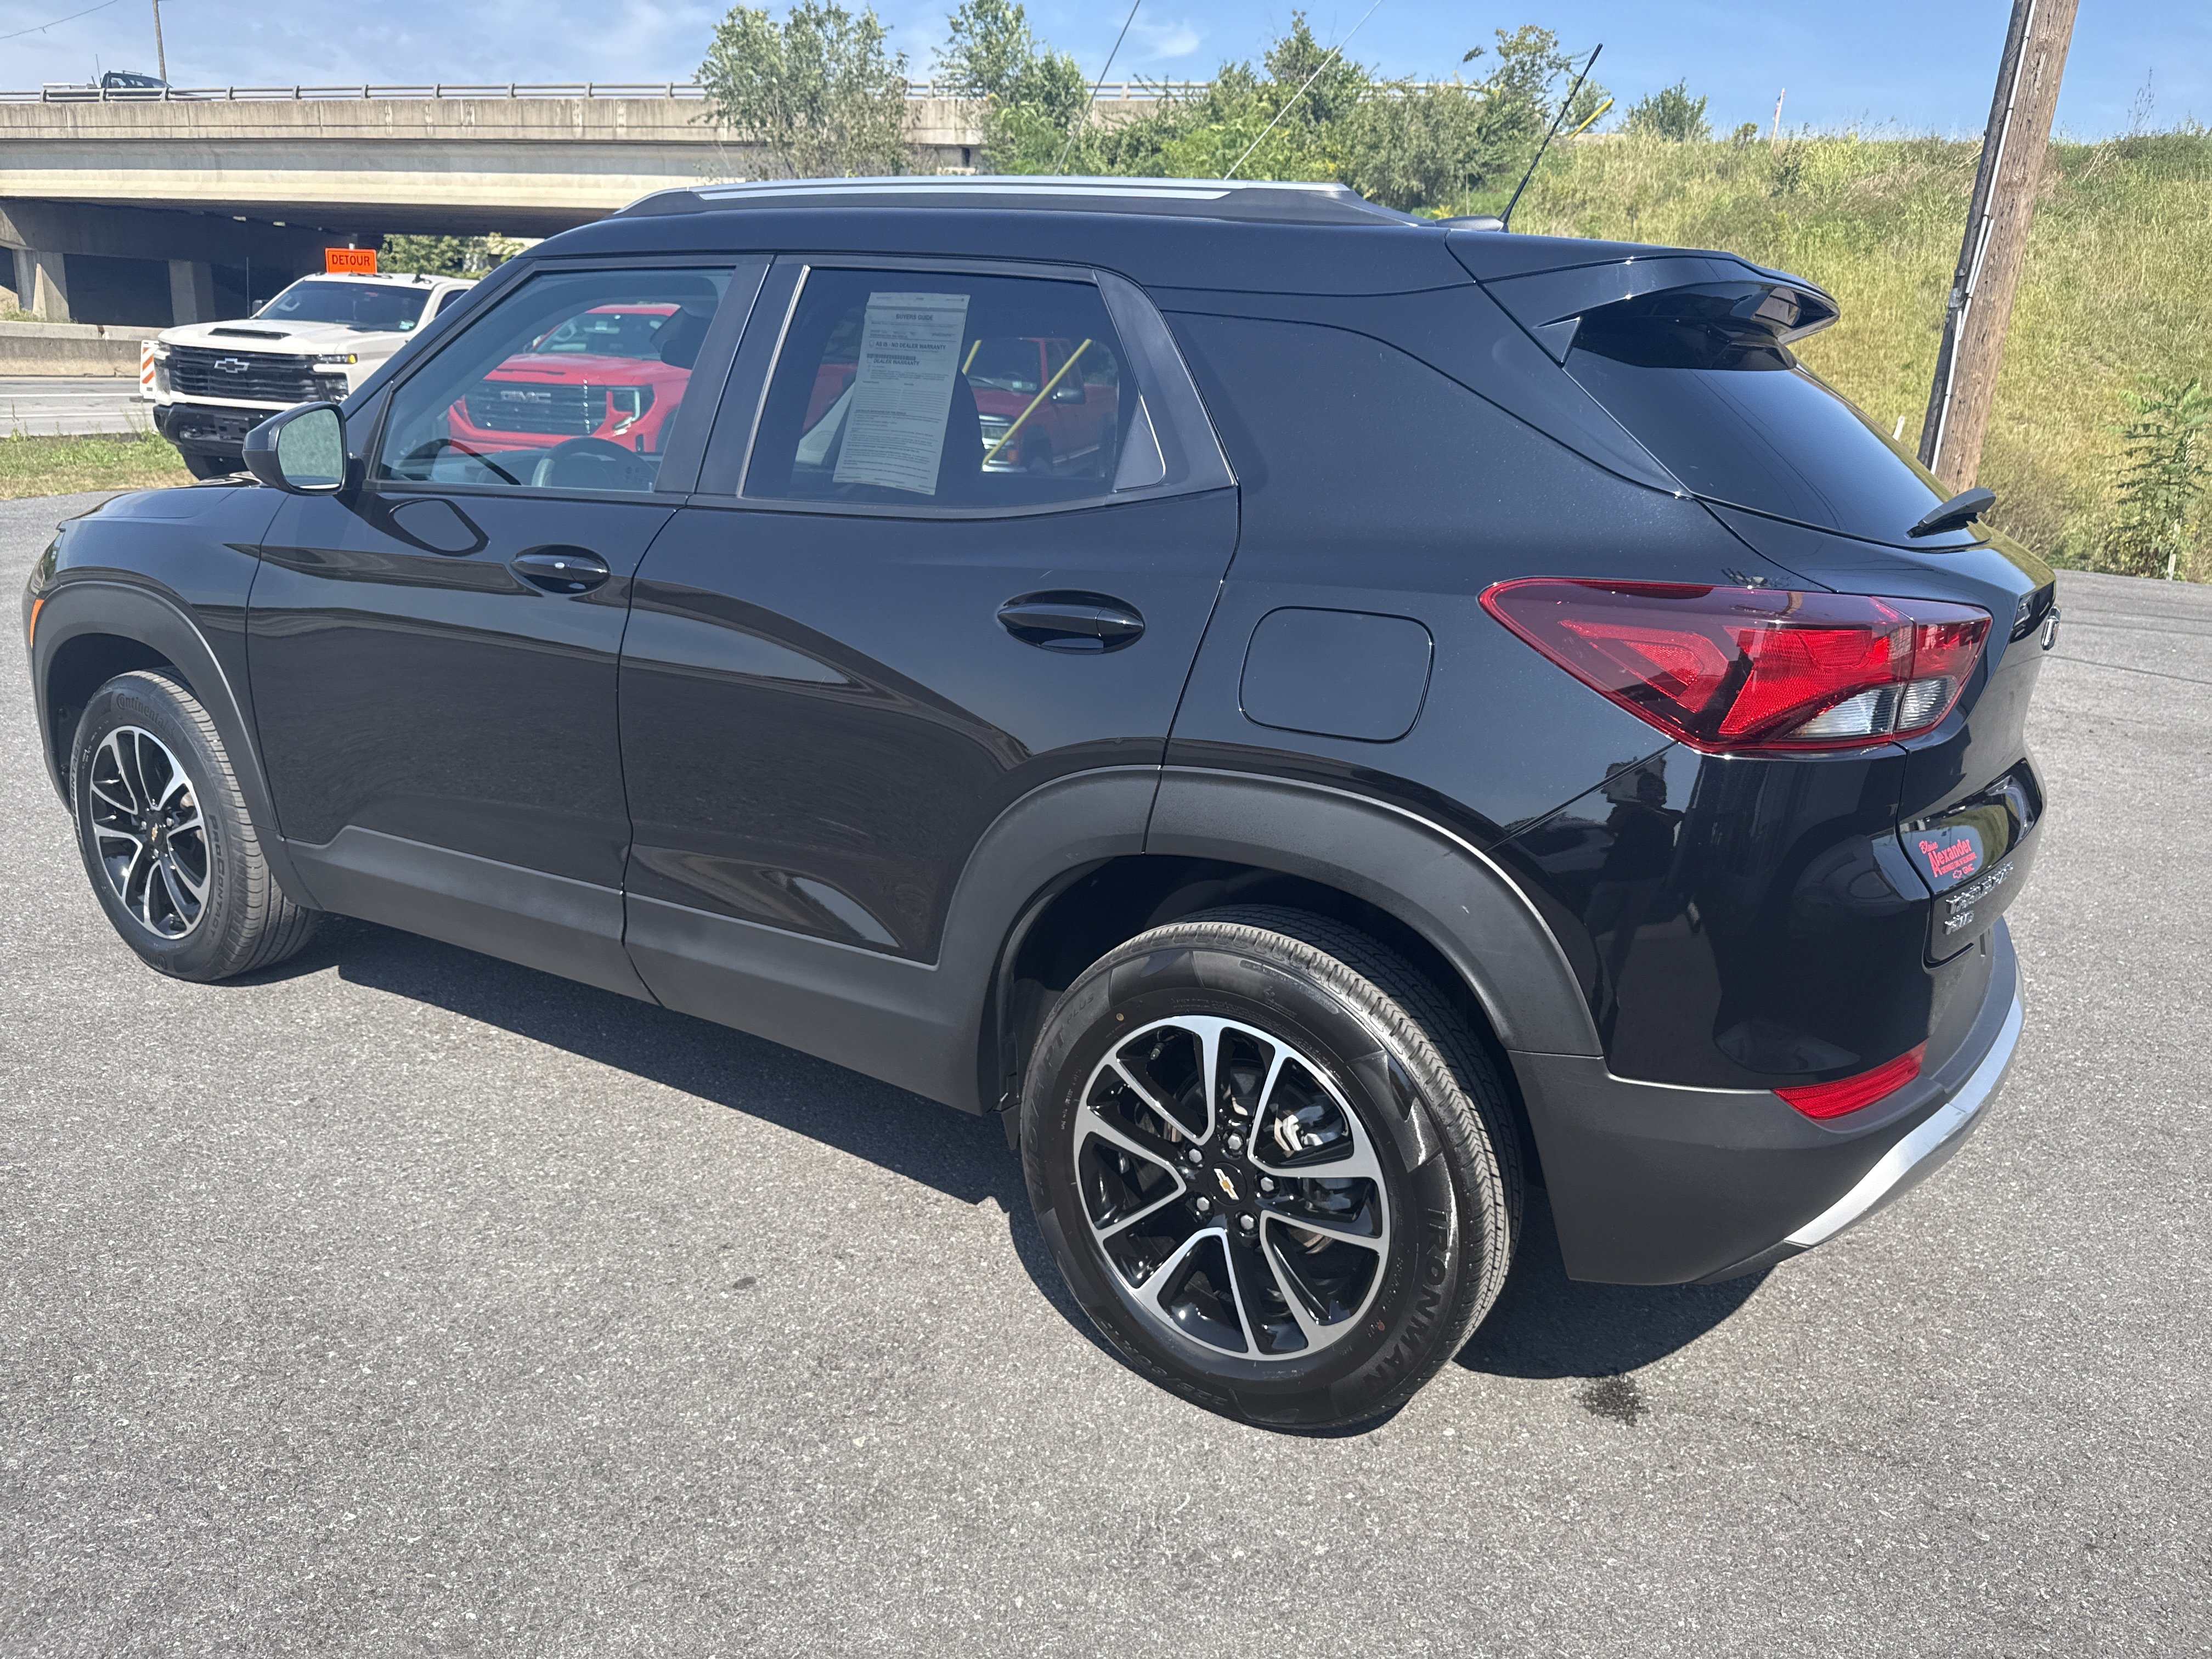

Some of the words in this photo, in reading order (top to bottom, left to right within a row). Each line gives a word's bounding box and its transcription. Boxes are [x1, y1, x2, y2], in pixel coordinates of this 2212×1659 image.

[331, 255, 370, 266] DETOUR
[208, 814, 225, 938] PROCONTACT
[1927, 839, 1972, 878] Alexander
[1362, 1207, 1448, 1394] IRONMAN
